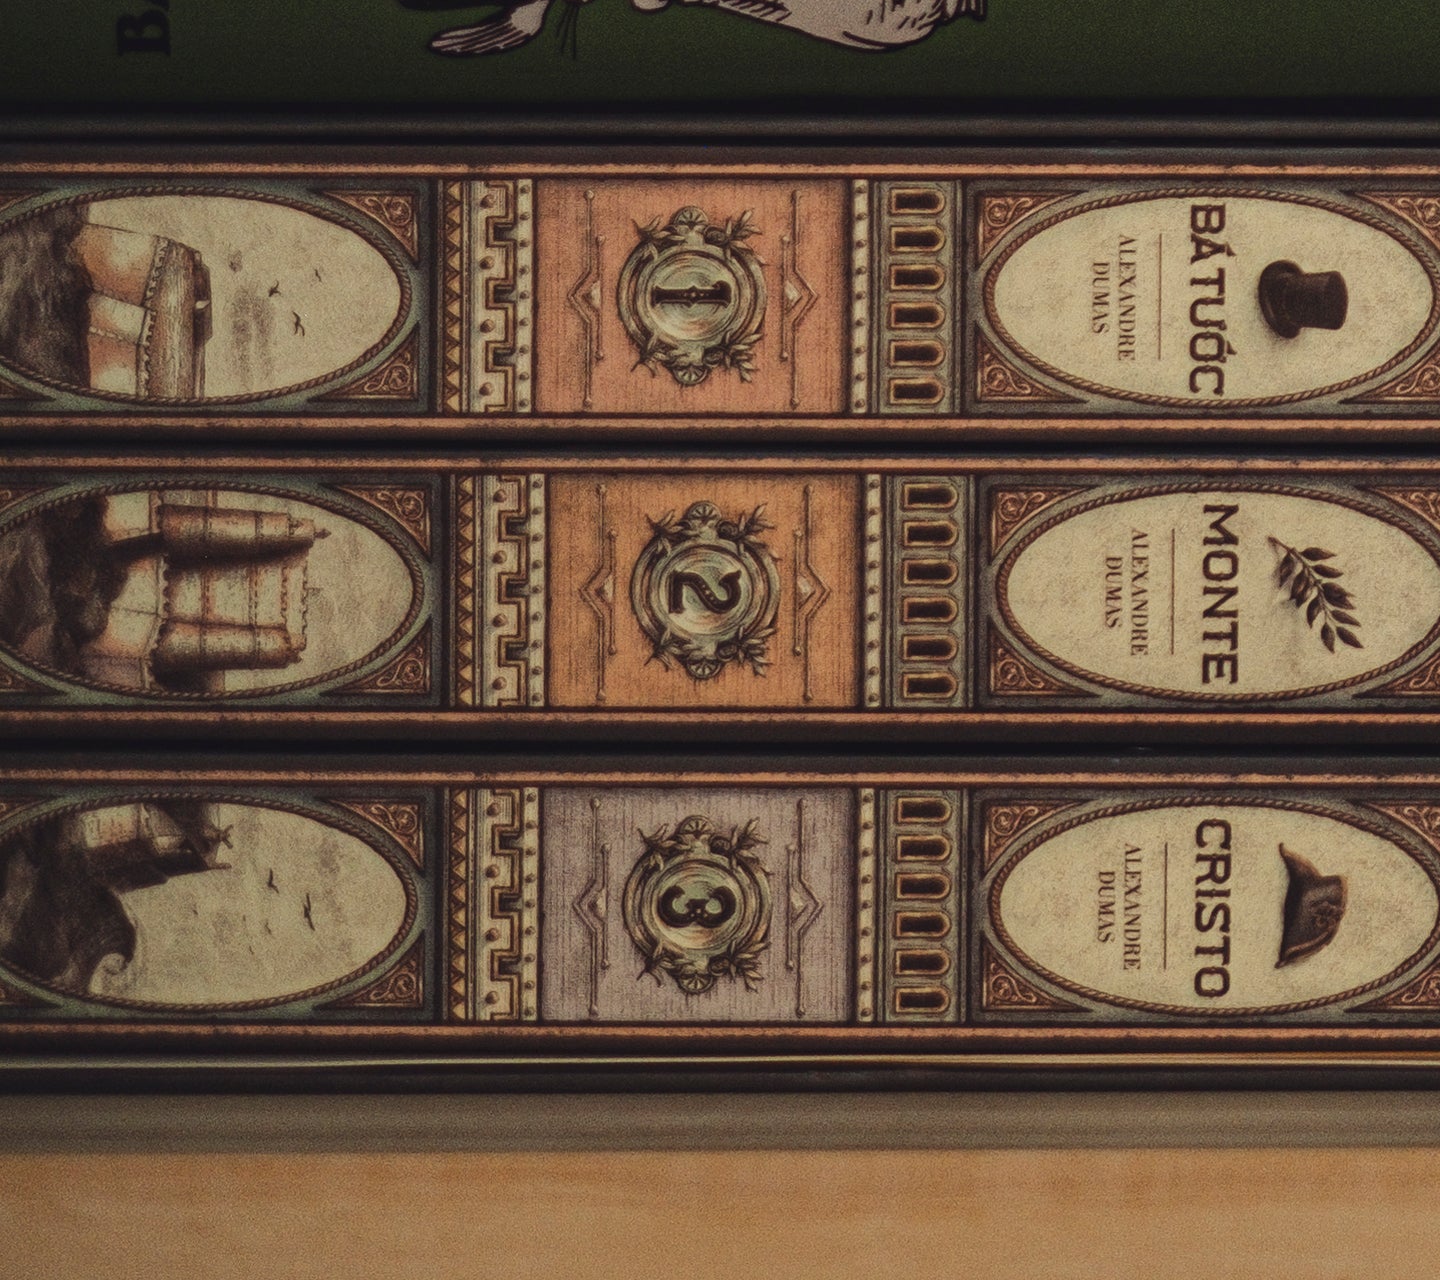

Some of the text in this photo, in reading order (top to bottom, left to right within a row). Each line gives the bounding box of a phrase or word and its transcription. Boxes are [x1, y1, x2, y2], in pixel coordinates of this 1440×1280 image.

[1091, 261, 1110, 335] DUMAS
[1116, 234, 1136, 362] ALEXANDRE
[1188, 203, 1236, 395] BÁ TƯỚC
[1104, 556, 1122, 628] DUMAS
[1130, 528, 1149, 657] ALEXANDRE
[1203, 505, 1240, 685] MONTE
[1097, 870, 1115, 942] DUMAS
[1124, 842, 1142, 970] ALEXANDRE
[1194, 818, 1232, 998] CRISTO
